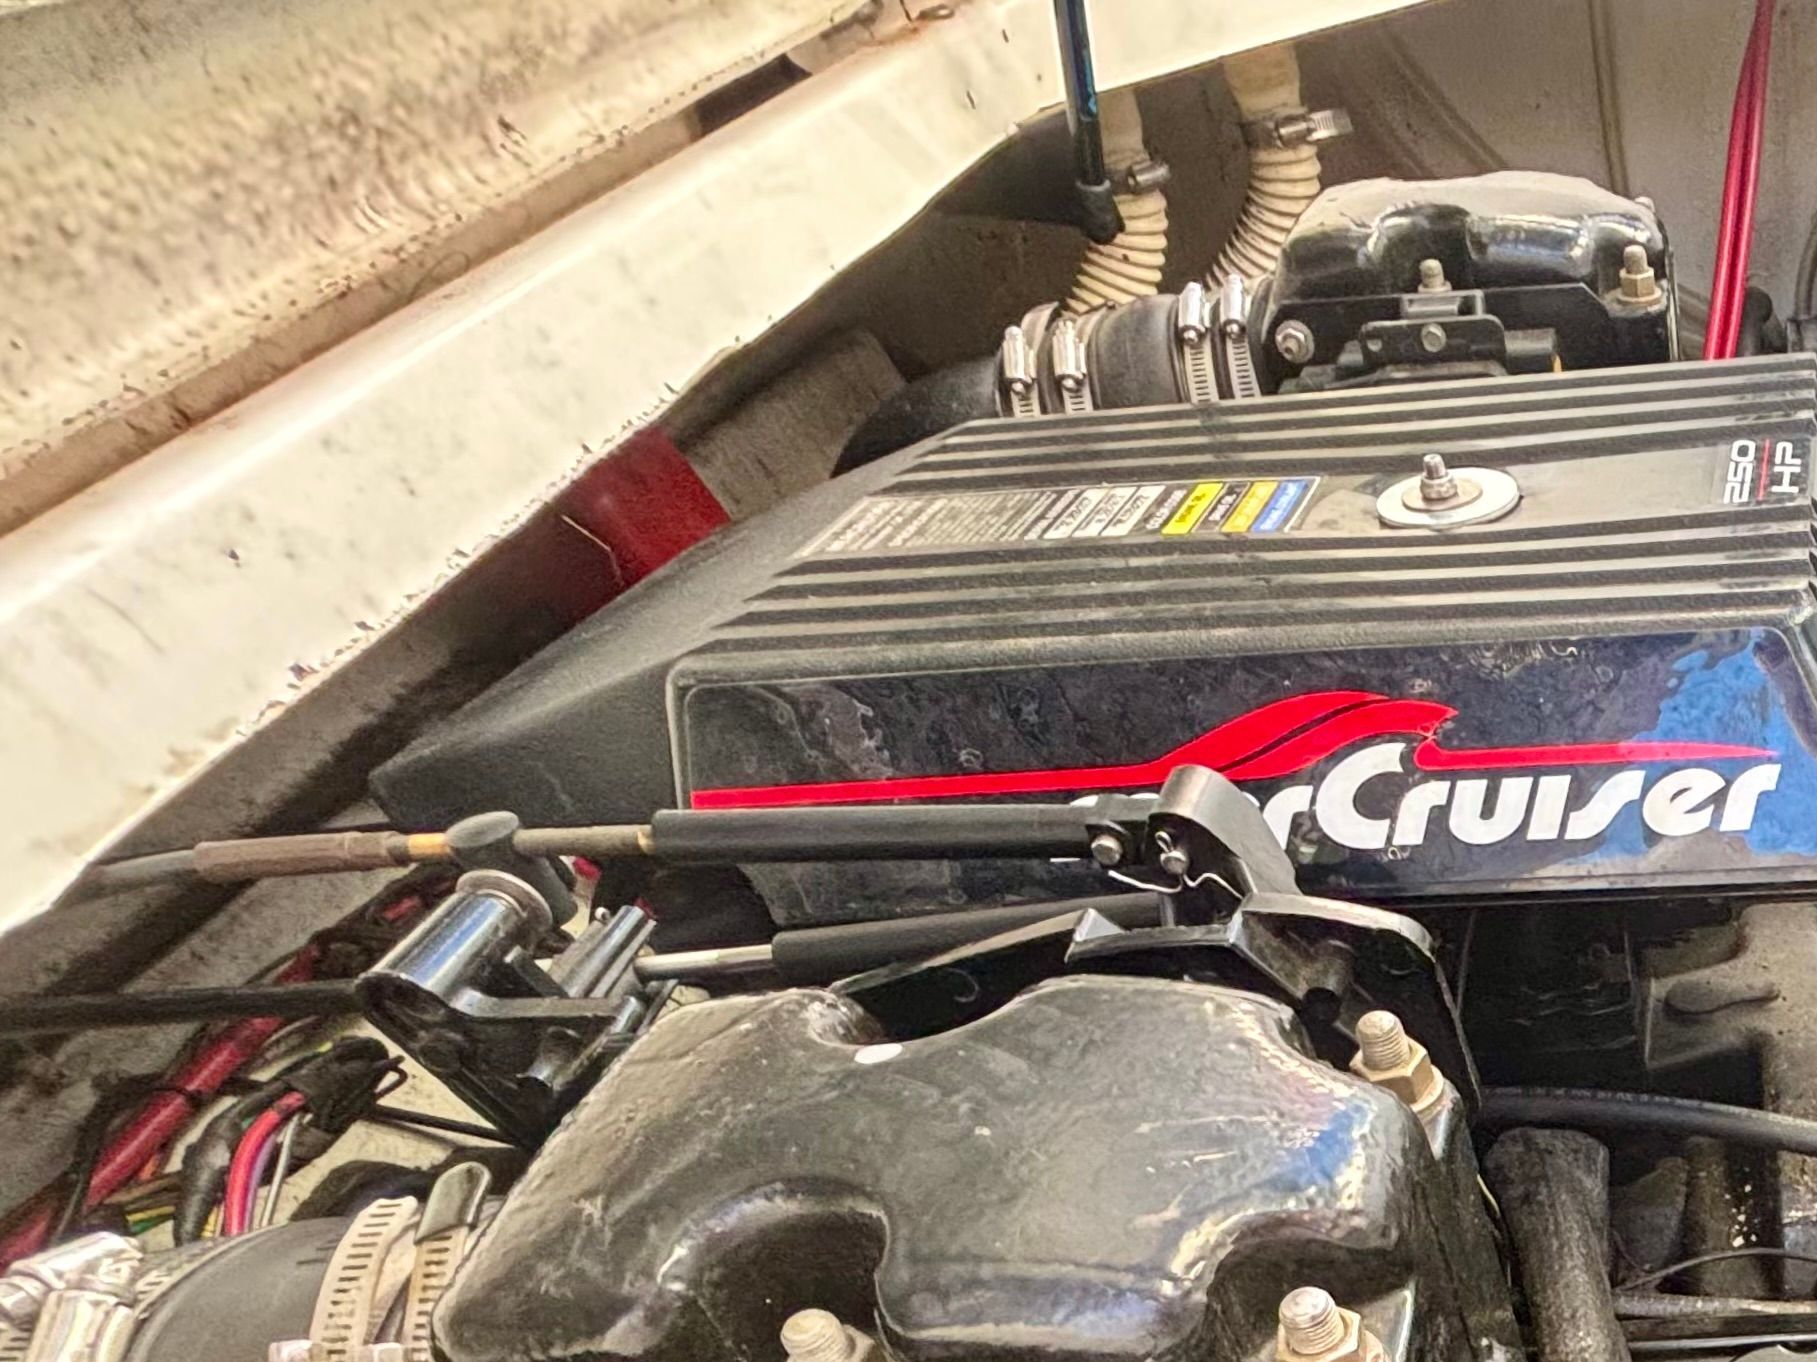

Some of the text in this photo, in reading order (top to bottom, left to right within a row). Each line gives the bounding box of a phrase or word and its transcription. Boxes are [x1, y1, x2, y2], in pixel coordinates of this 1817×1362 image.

[1724, 439, 1757, 505] 250
[1771, 441, 1803, 494] HP
[1050, 742, 1783, 862] rCruiser
